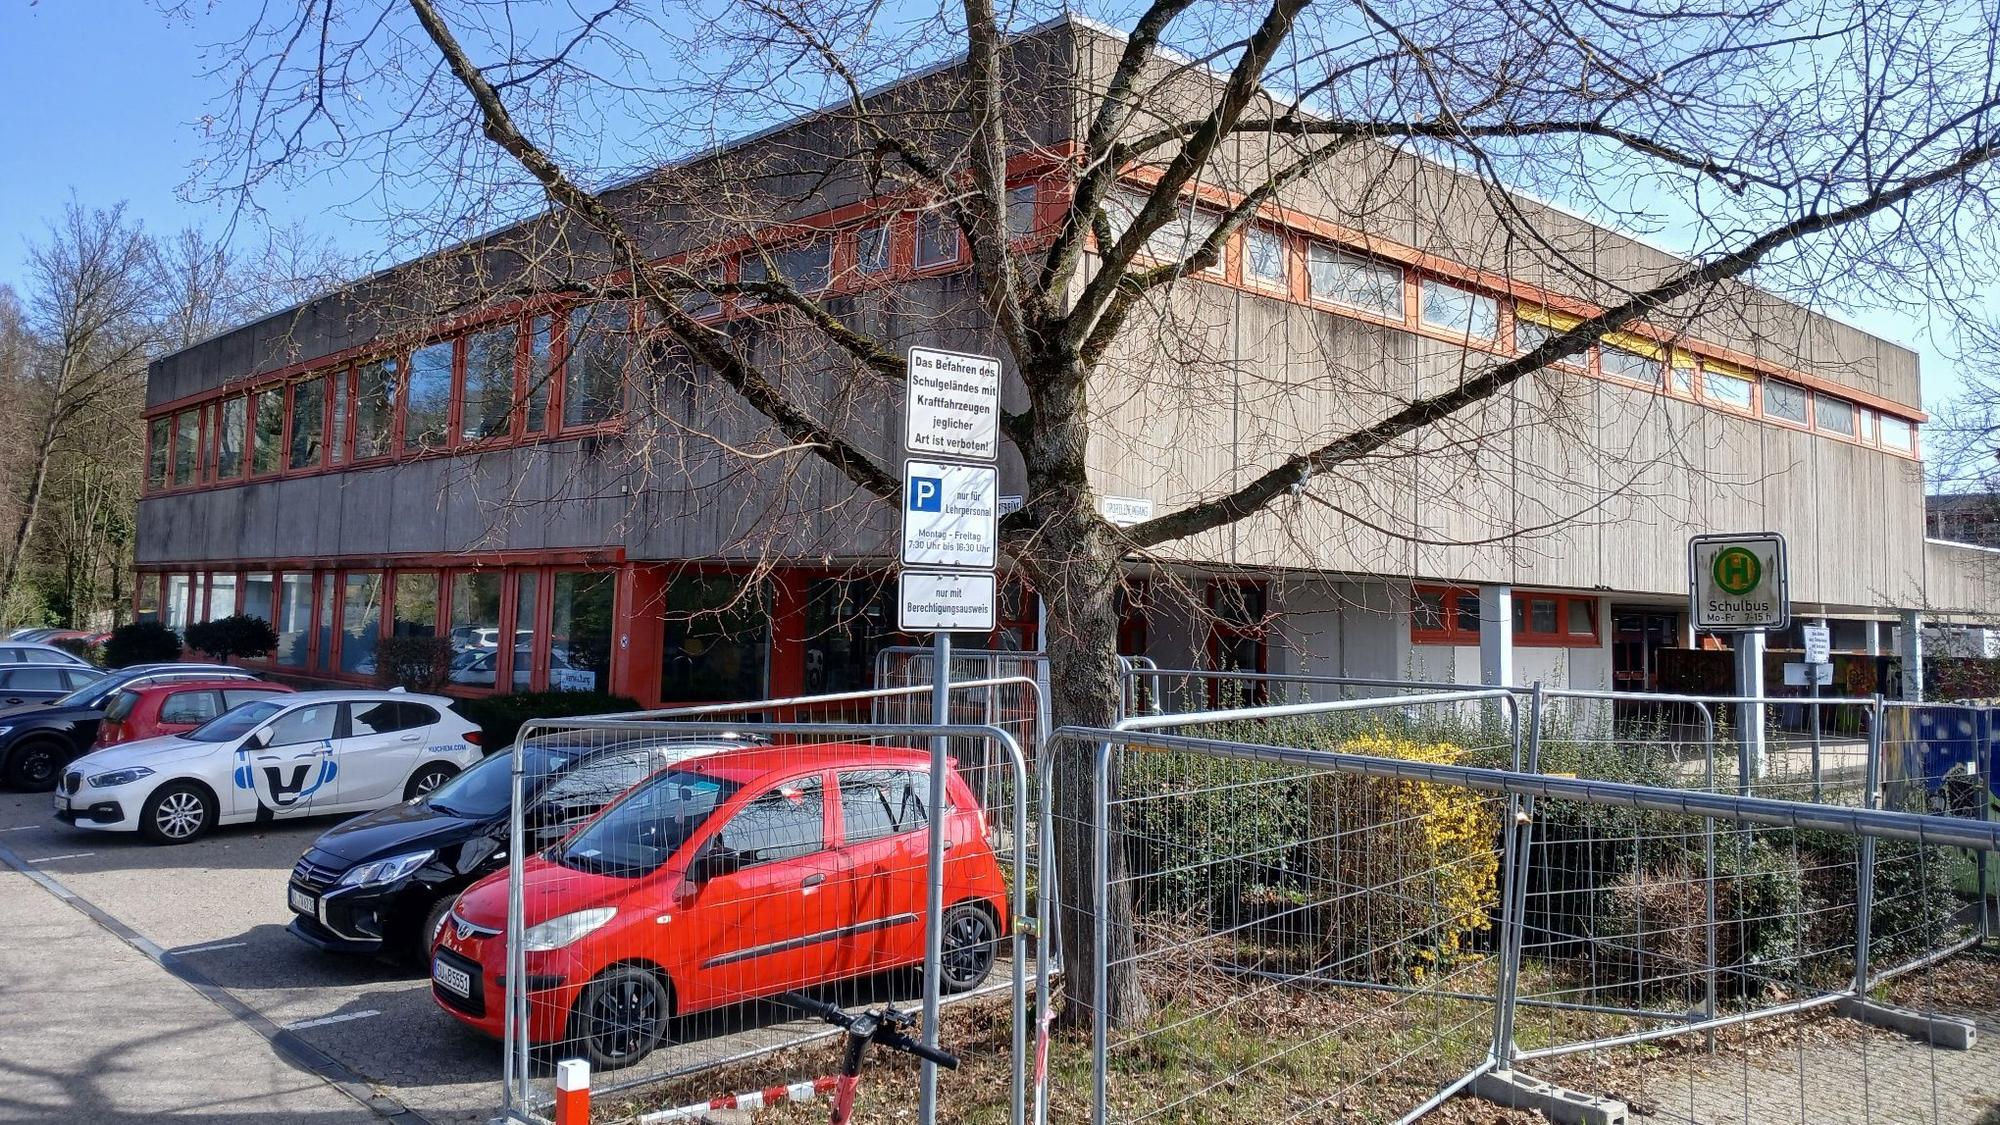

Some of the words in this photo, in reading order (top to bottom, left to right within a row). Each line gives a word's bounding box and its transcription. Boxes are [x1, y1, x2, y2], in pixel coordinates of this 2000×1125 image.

[915, 356, 932, 368] Das
[936, 359, 976, 375] Befahren
[979, 366, 995, 377] des
[913, 375, 979, 393] Schulgeländes
[981, 385, 996, 396] mit
[917, 394, 990, 415] Kraftfahrzeugen
[932, 416, 973, 430] jeglicher
[915, 433, 930, 445] Art
[932, 434, 944, 446] ist
[946, 438, 989, 451] verboten!
[917, 480, 935, 507] P
[956, 491, 969, 500] nur
[970, 490, 981, 501] für
[945, 503, 992, 517] Lehrpersonal
[918, 528, 947, 540] Montag
[954, 530, 982, 542] Freitag
[908, 540, 925, 549] 7:30
[926, 540, 941, 550] Uhr
[942, 542, 954, 551] bis
[956, 543, 975, 552] 16:30
[976, 543, 991, 553] Uhr
[1725, 557, 1749, 584] H
[935, 589, 948, 598] nur
[949, 587, 962, 598] mit
[907, 601, 989, 616] Berechtigungsausweis
[1709, 600, 1769, 612] Schulbus
[1707, 613, 1736, 622] Mo-Fr
[1744, 612, 1764, 621] 7-15
[1765, 612, 1772, 621] h
